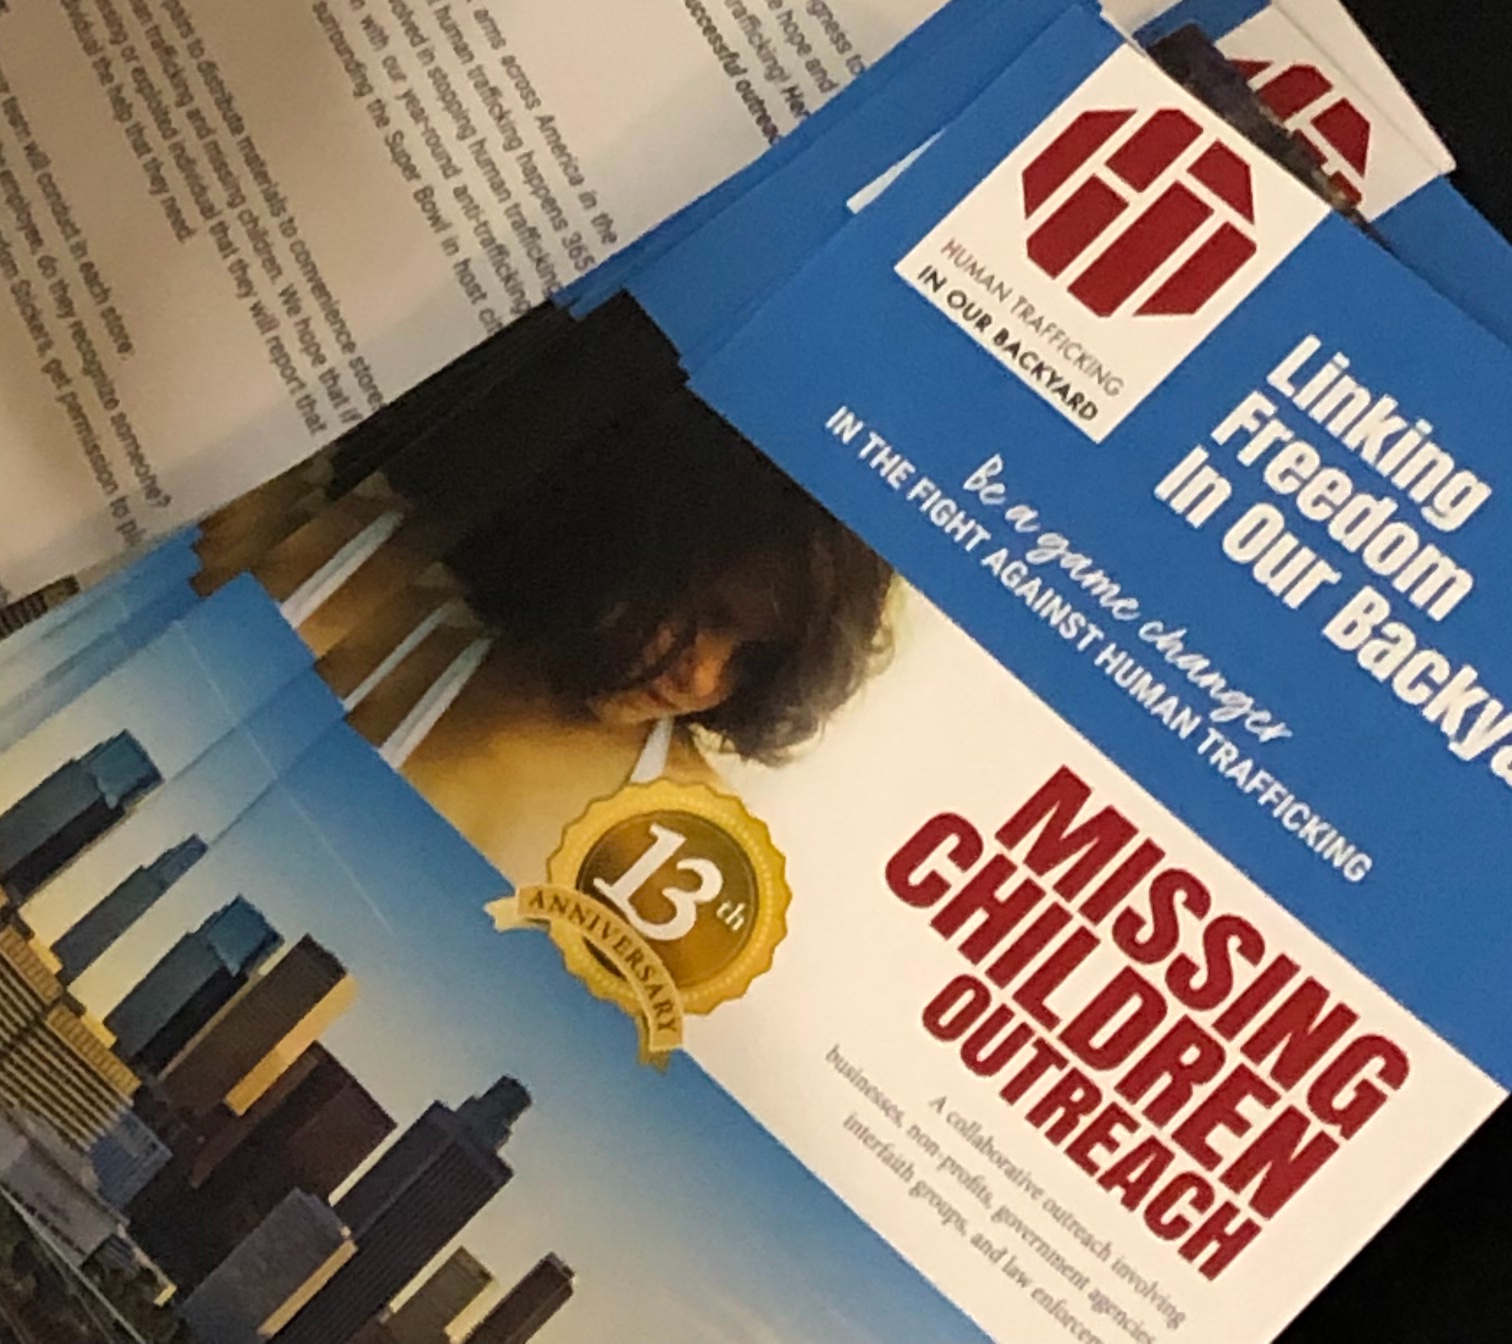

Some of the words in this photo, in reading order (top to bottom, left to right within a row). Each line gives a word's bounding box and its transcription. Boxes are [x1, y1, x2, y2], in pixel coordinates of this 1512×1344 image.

[732, 76, 786, 145] outrea
[769, 8, 817, 61] hope
[802, 55, 839, 94] and
[778, 83, 815, 123] Her
[842, 53, 868, 76] to
[276, 284, 306, 319] We
[288, 316, 331, 370] hope
[914, 262, 951, 296] IN
[943, 286, 998, 336] OUR
[990, 326, 1103, 425] BACKYARD
[937, 237, 1015, 306] HUMAN
[1007, 294, 1127, 401] TRAFFICKING
[318, 366, 352, 408] that
[1264, 332, 1494, 537] Linking
[961, 453, 1024, 511] Be
[999, 498, 1046, 541] a
[1150, 444, 1243, 530] In
[1213, 496, 1347, 618] Our
[1209, 389, 1478, 621] Freedom
[824, 405, 867, 445] IN
[854, 432, 918, 490] THE
[902, 476, 992, 557] FIGHT
[977, 542, 1103, 654] AGAINST
[1090, 639, 1205, 741] HUMAN
[1190, 722, 1376, 887] TRAFFICKING
[1022, 527, 1144, 636] game
[1126, 612, 1295, 762] changer
[528, 891, 676, 1032] ANNIVERSARY
[870, 803, 1343, 1222] CHILDREN
[989, 759, 1422, 1144] MISSING
[819, 1043, 916, 1130] businesses,
[900, 1120, 1005, 1213] non-profits,
[989, 1202, 1093, 1293] government
[839, 1111, 920, 1183] interfaith
[905, 1176, 977, 1240] groups,
[967, 1229, 1007, 1265] and
[998, 1256, 1036, 1290] law
[909, 968, 1265, 1283] OUTREACH
[925, 1093, 951, 1116] A
[940, 1105, 1050, 1202] collaborative
[1038, 1193, 1117, 1263] outreach
[1105, 1255, 1190, 1331] involving
